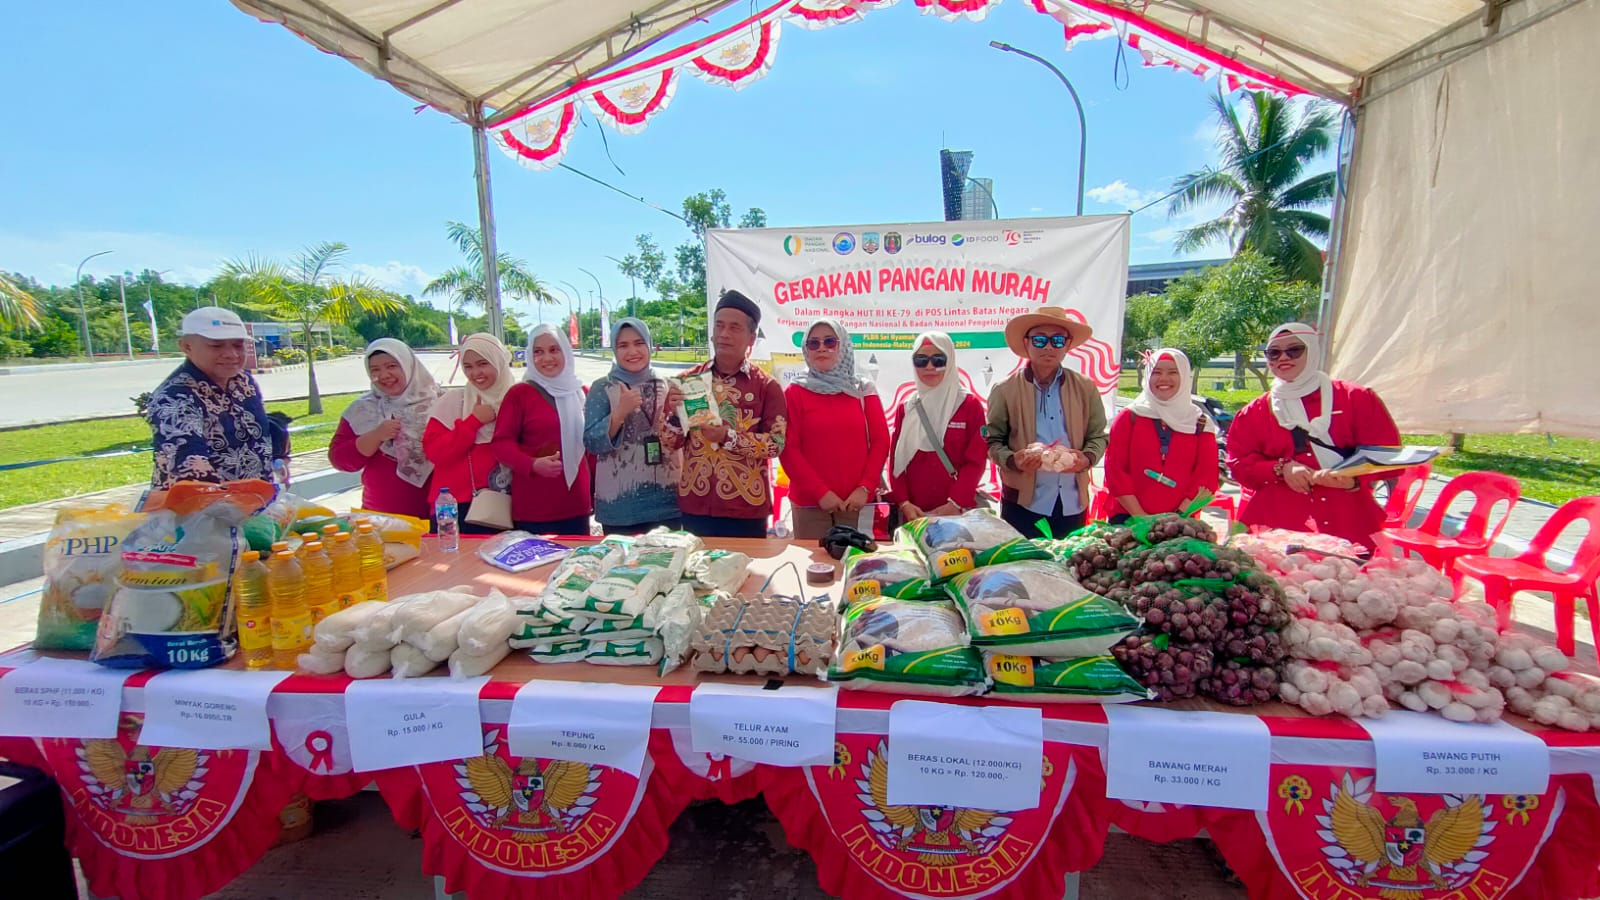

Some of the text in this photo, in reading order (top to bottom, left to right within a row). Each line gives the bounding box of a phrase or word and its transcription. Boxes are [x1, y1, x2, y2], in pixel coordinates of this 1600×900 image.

[915, 233, 946, 245] bulog
[774, 267, 1051, 305] GERAKAN PANGAN MURAH
[794, 307, 821, 316] Dalam
[823, 308, 855, 318] Rangka
[886, 309, 911, 317] KE-79
[925, 308, 942, 316] POS
[944, 307, 970, 316] Lintas
[972, 306, 997, 315] Batas
[999, 306, 1030, 316] Negara
[777, 317, 809, 327] Kerjasam
[934, 319, 967, 328] Nasional
[968, 319, 1004, 327] Pengelola
[990, 616, 1021, 627] 10Kg
[996, 662, 1027, 673] 10Kg
[175, 700, 237, 711] MINYAK GORENG
[403, 712, 426, 722] GULA
[387, 729, 400, 737] Rp.
[402, 724, 426, 735] 15.000
[734, 723, 789, 734] TELUR AYAM
[561, 730, 595, 740] TEPUNG
[551, 740, 564, 748] Rp.
[722, 735, 736, 743] RP.
[738, 736, 764, 746] 55.000
[770, 739, 799, 748] PIRING
[907, 754, 1022, 770] BERAS LOKAL (12.000/KG)
[1422, 751, 1501, 761] BAWANG PUTIH
[1148, 760, 1228, 773] BAWANG MERAH
[1426, 766, 1441, 776] Rp.
[1445, 767, 1475, 775] 33.000
[1483, 767, 1499, 776] KG
[931, 767, 945, 775] KG
[954, 769, 969, 778] Rp.
[971, 771, 1008, 780] 120.000,-
[1154, 774, 1169, 784] Rp.
[1171, 775, 1200, 785] 33.000
[1207, 778, 1221, 787] KG
[72, 787, 227, 850] INDONESIA
[443, 806, 616, 868] INDONESIA
[841, 824, 1033, 893] INDONESIA
